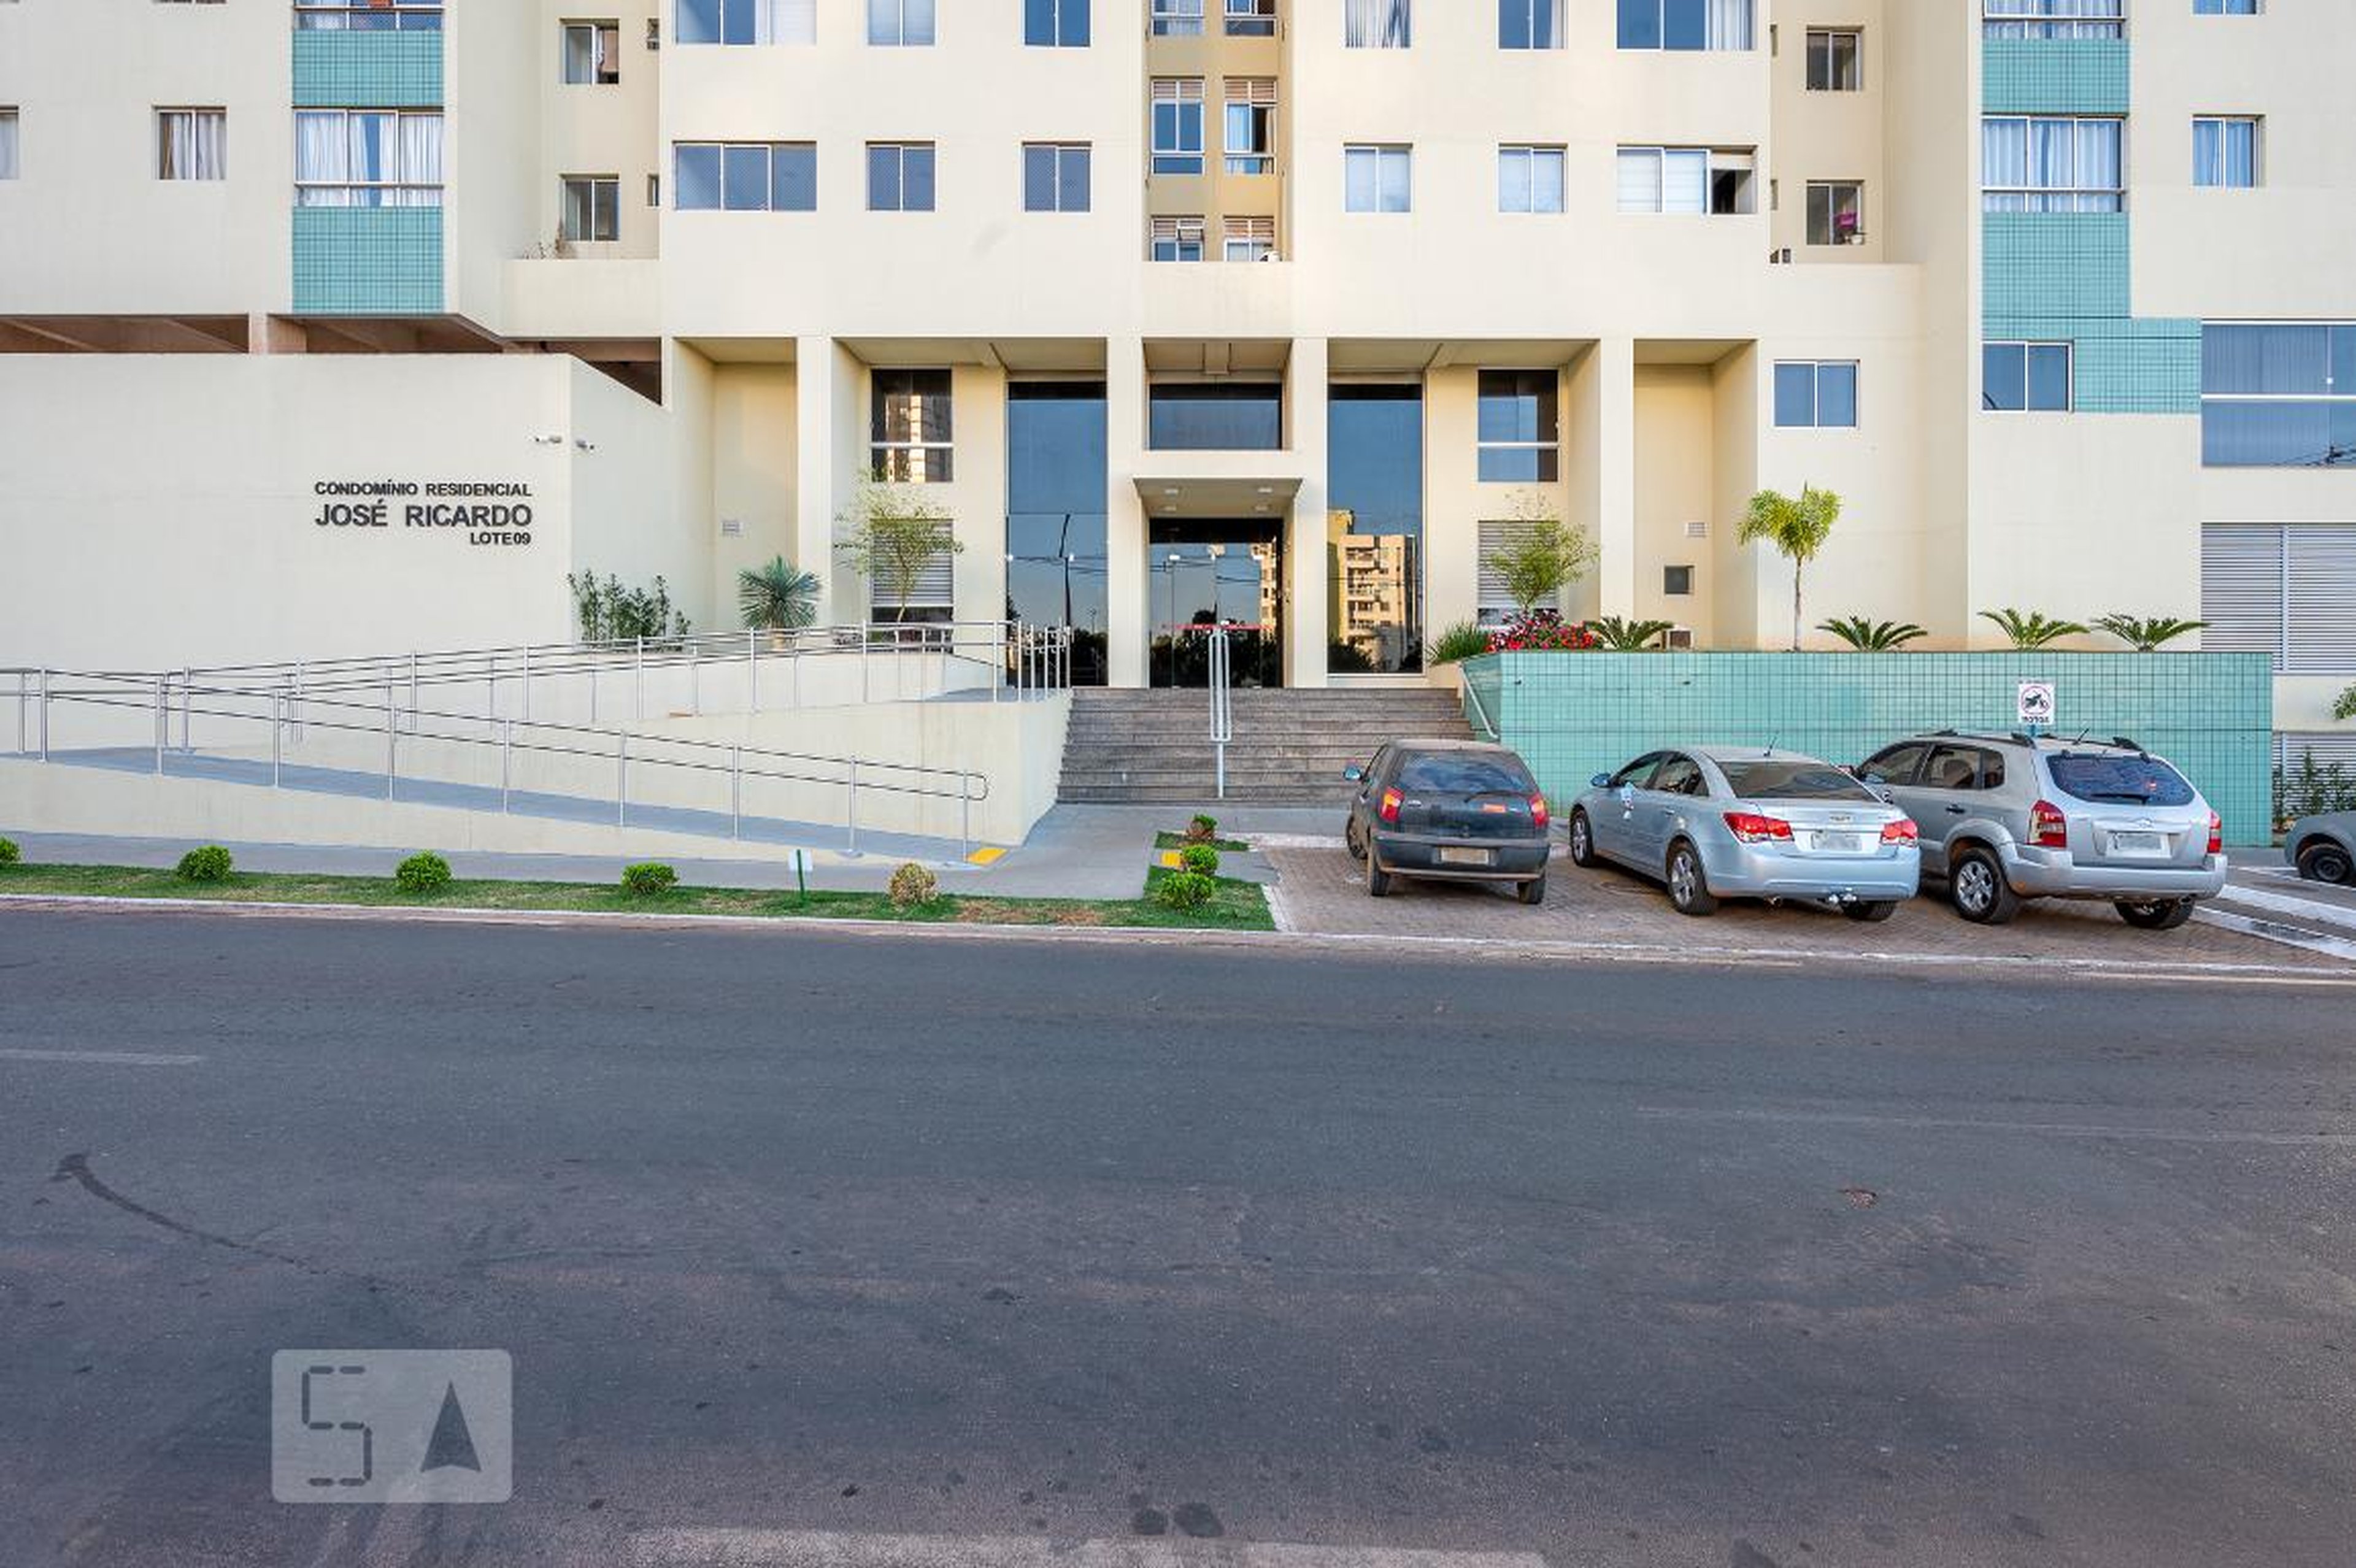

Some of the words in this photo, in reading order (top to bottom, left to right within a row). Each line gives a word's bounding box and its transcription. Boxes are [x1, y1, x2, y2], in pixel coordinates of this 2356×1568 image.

[315, 479, 418, 496] CONDOMÍNIO
[426, 483, 532, 496] RESIDENCIAL
[315, 498, 388, 526] JOSÉ
[405, 504, 533, 527] RICARDO
